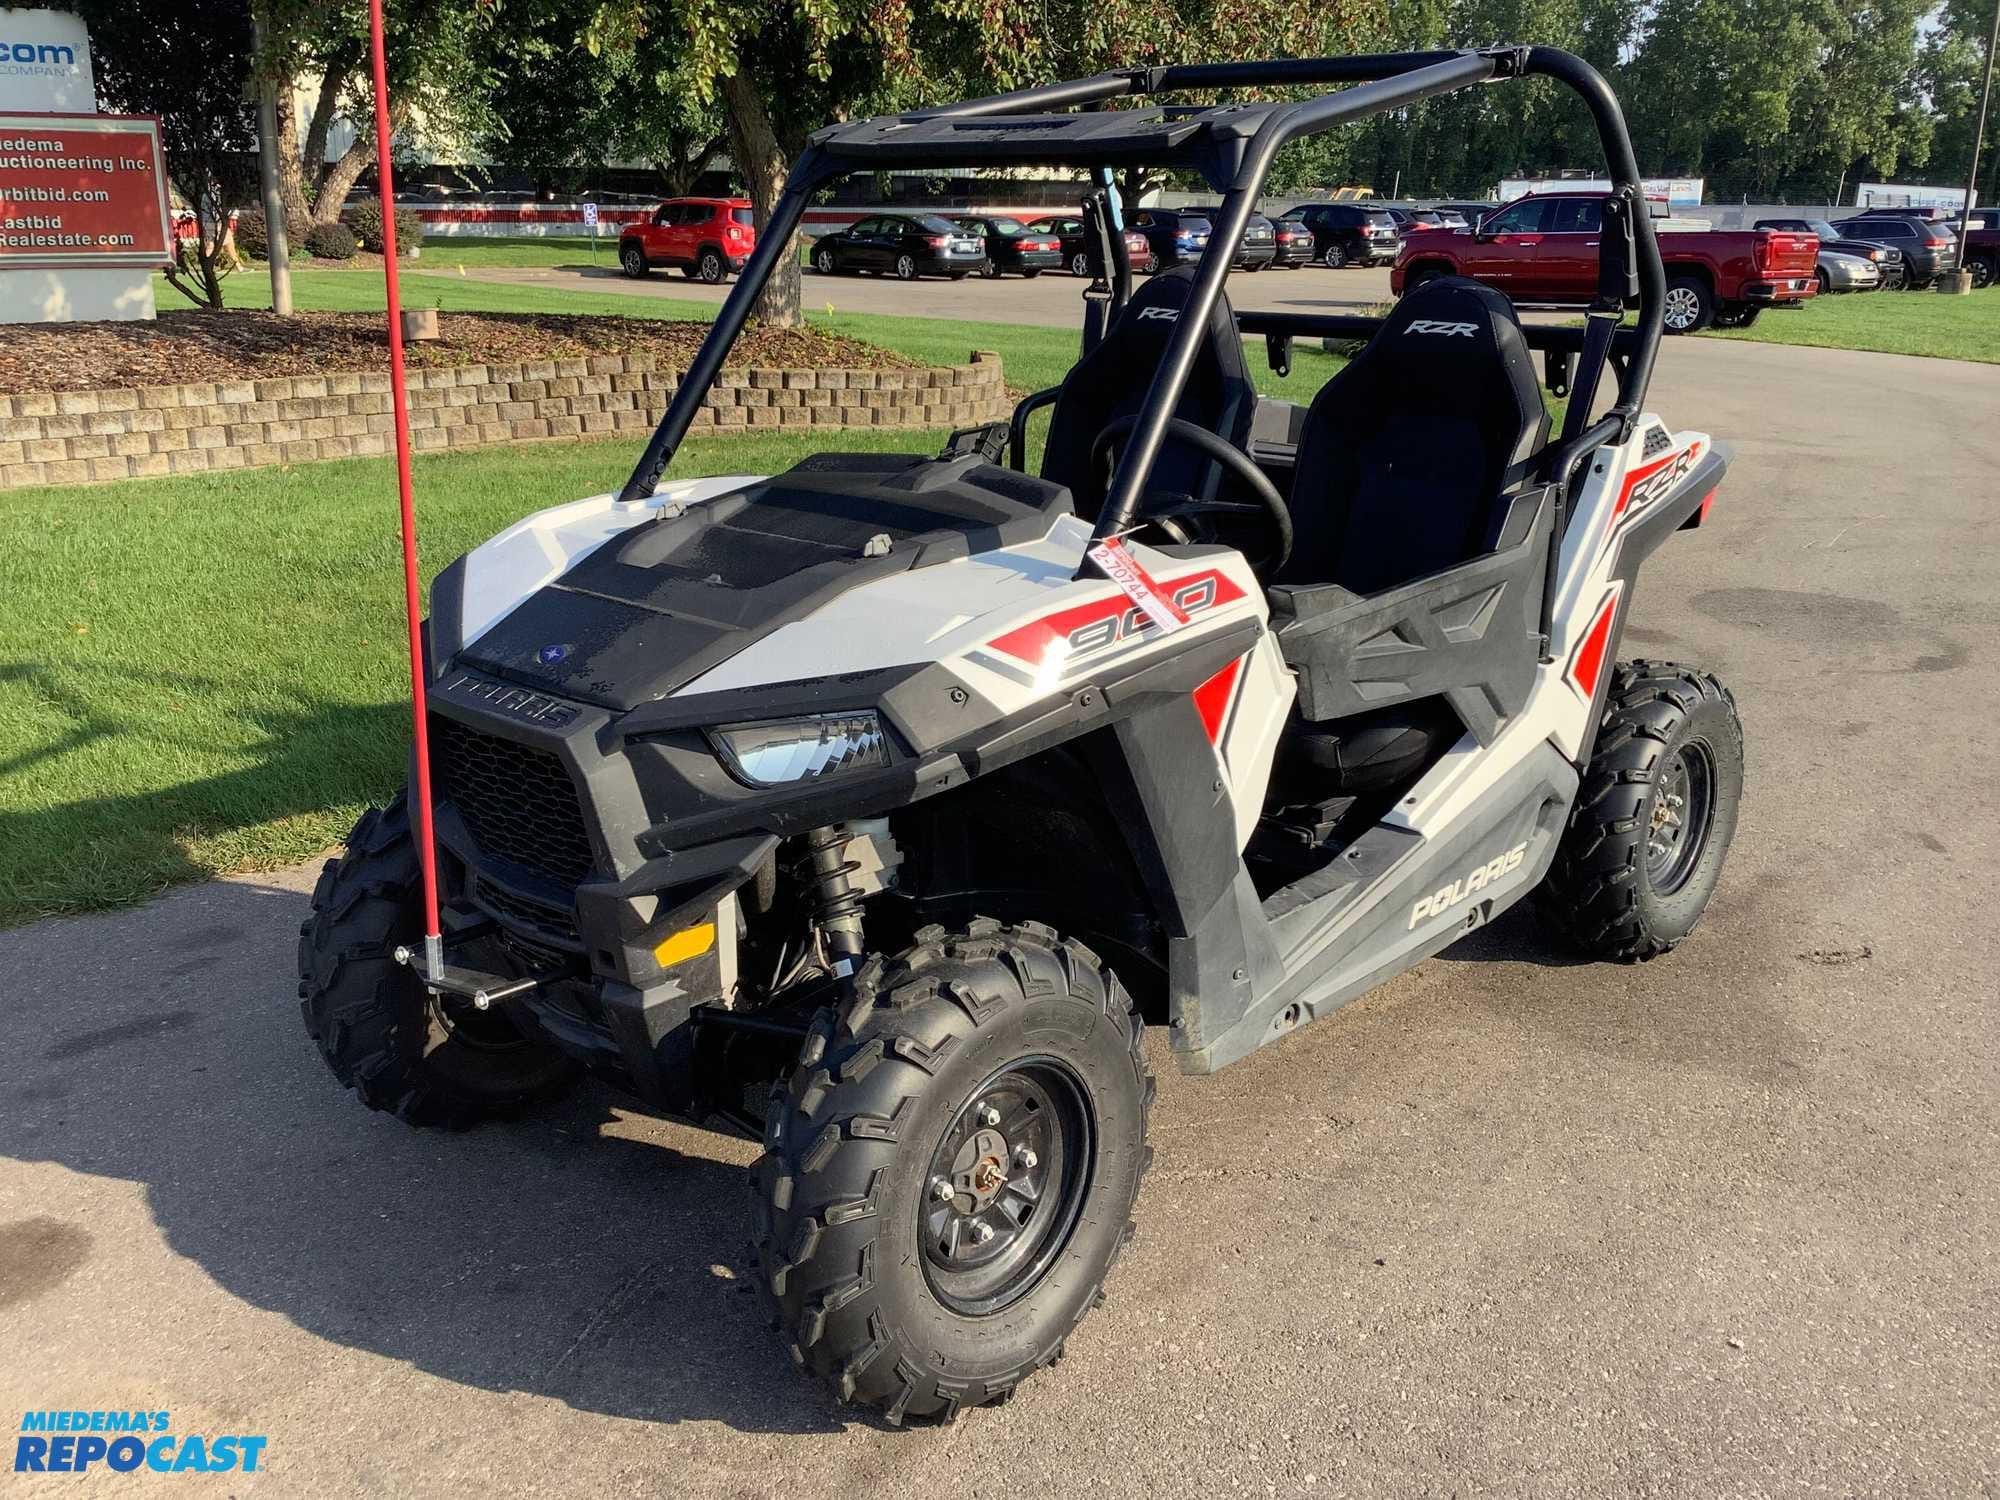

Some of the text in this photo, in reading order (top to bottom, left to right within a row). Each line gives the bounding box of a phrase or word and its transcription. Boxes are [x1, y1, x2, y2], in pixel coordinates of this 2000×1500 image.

[119, 156, 151, 170] Inc.
[1137, 306, 1178, 322] RZ
[1403, 319, 1480, 338] RZR
[1623, 448, 1692, 517] RZR
[1093, 549, 1151, 601] 2-70744
[1407, 840, 1530, 931] POLARIS
